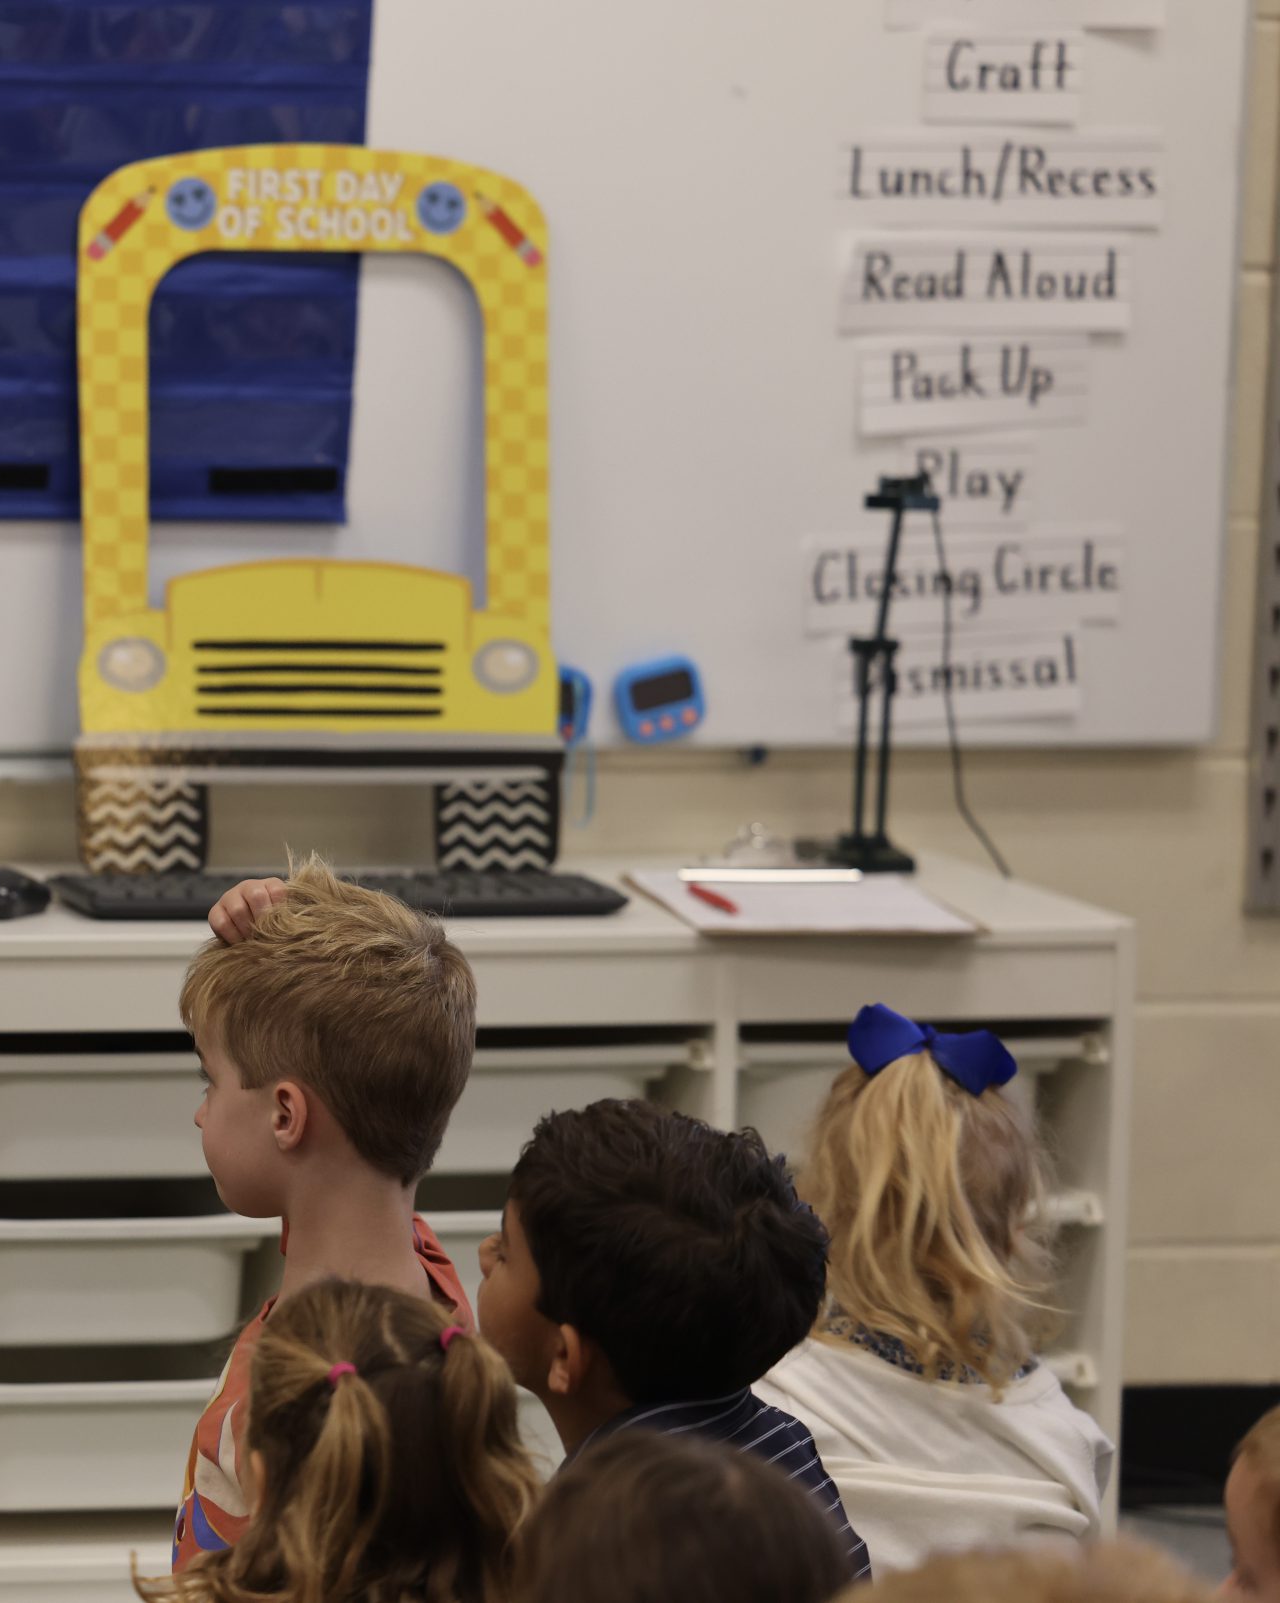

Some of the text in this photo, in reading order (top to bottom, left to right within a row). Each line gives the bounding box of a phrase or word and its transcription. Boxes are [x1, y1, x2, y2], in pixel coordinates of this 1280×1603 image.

[945, 38, 1070, 92] Craft
[227, 168, 406, 203] FIRST DAY
[848, 140, 1158, 203] Lunch/Recess
[218, 206, 413, 242] OF SCHOOL
[861, 247, 1117, 302] Read Aloud
[891, 343, 1055, 407] Pack Up
[916, 448, 1025, 515] Play
[995, 539, 1118, 593] Circle
[864, 635, 1077, 696] smissal
